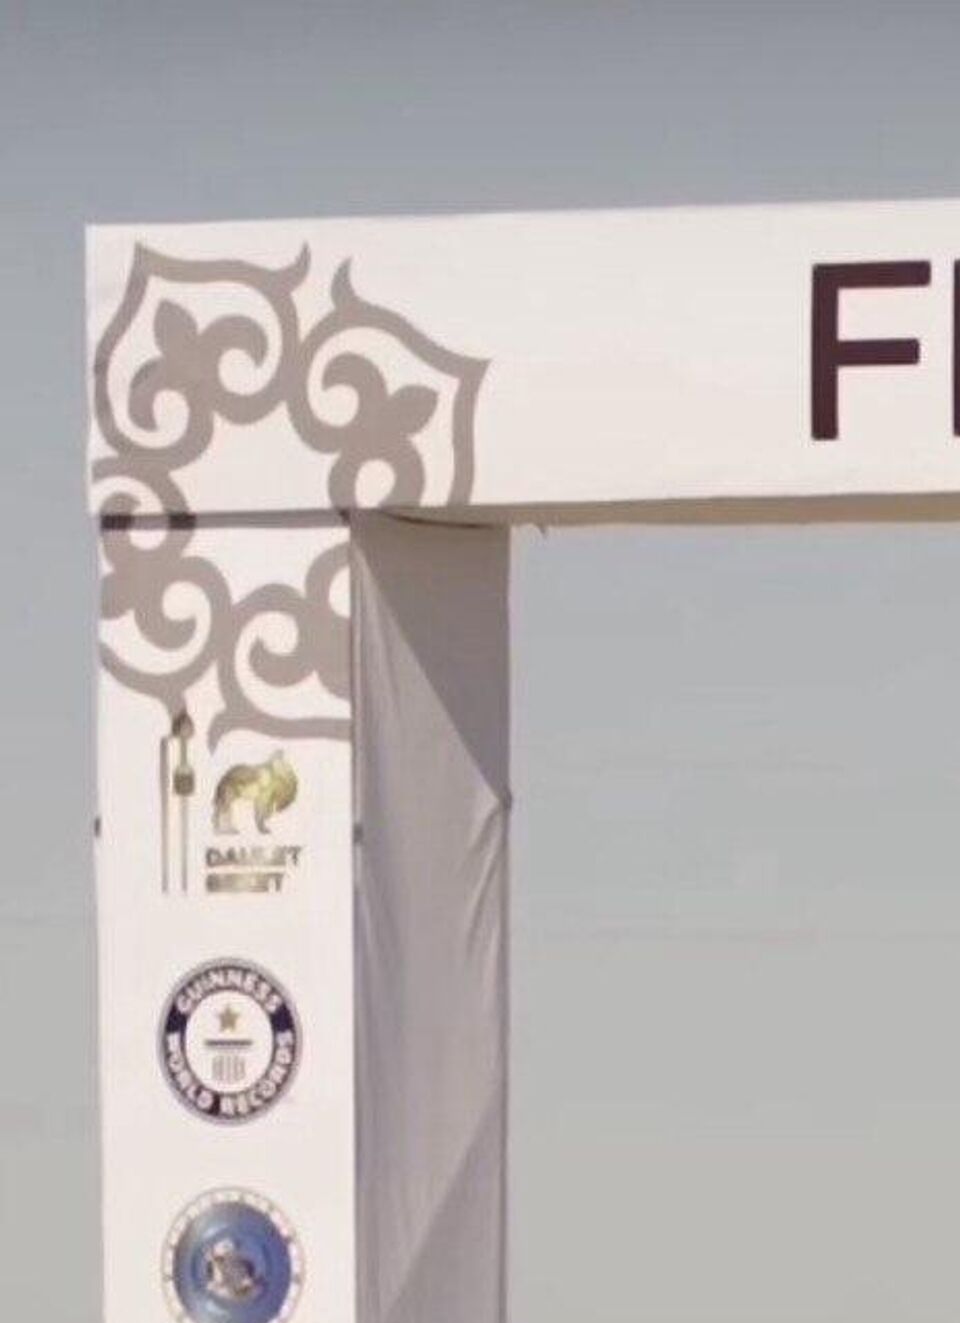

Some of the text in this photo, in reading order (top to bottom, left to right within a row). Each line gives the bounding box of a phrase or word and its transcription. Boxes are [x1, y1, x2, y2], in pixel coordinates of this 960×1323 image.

[176, 968, 283, 1014] GUINNESS
[166, 1030, 295, 1115] WORLD RECORDS
